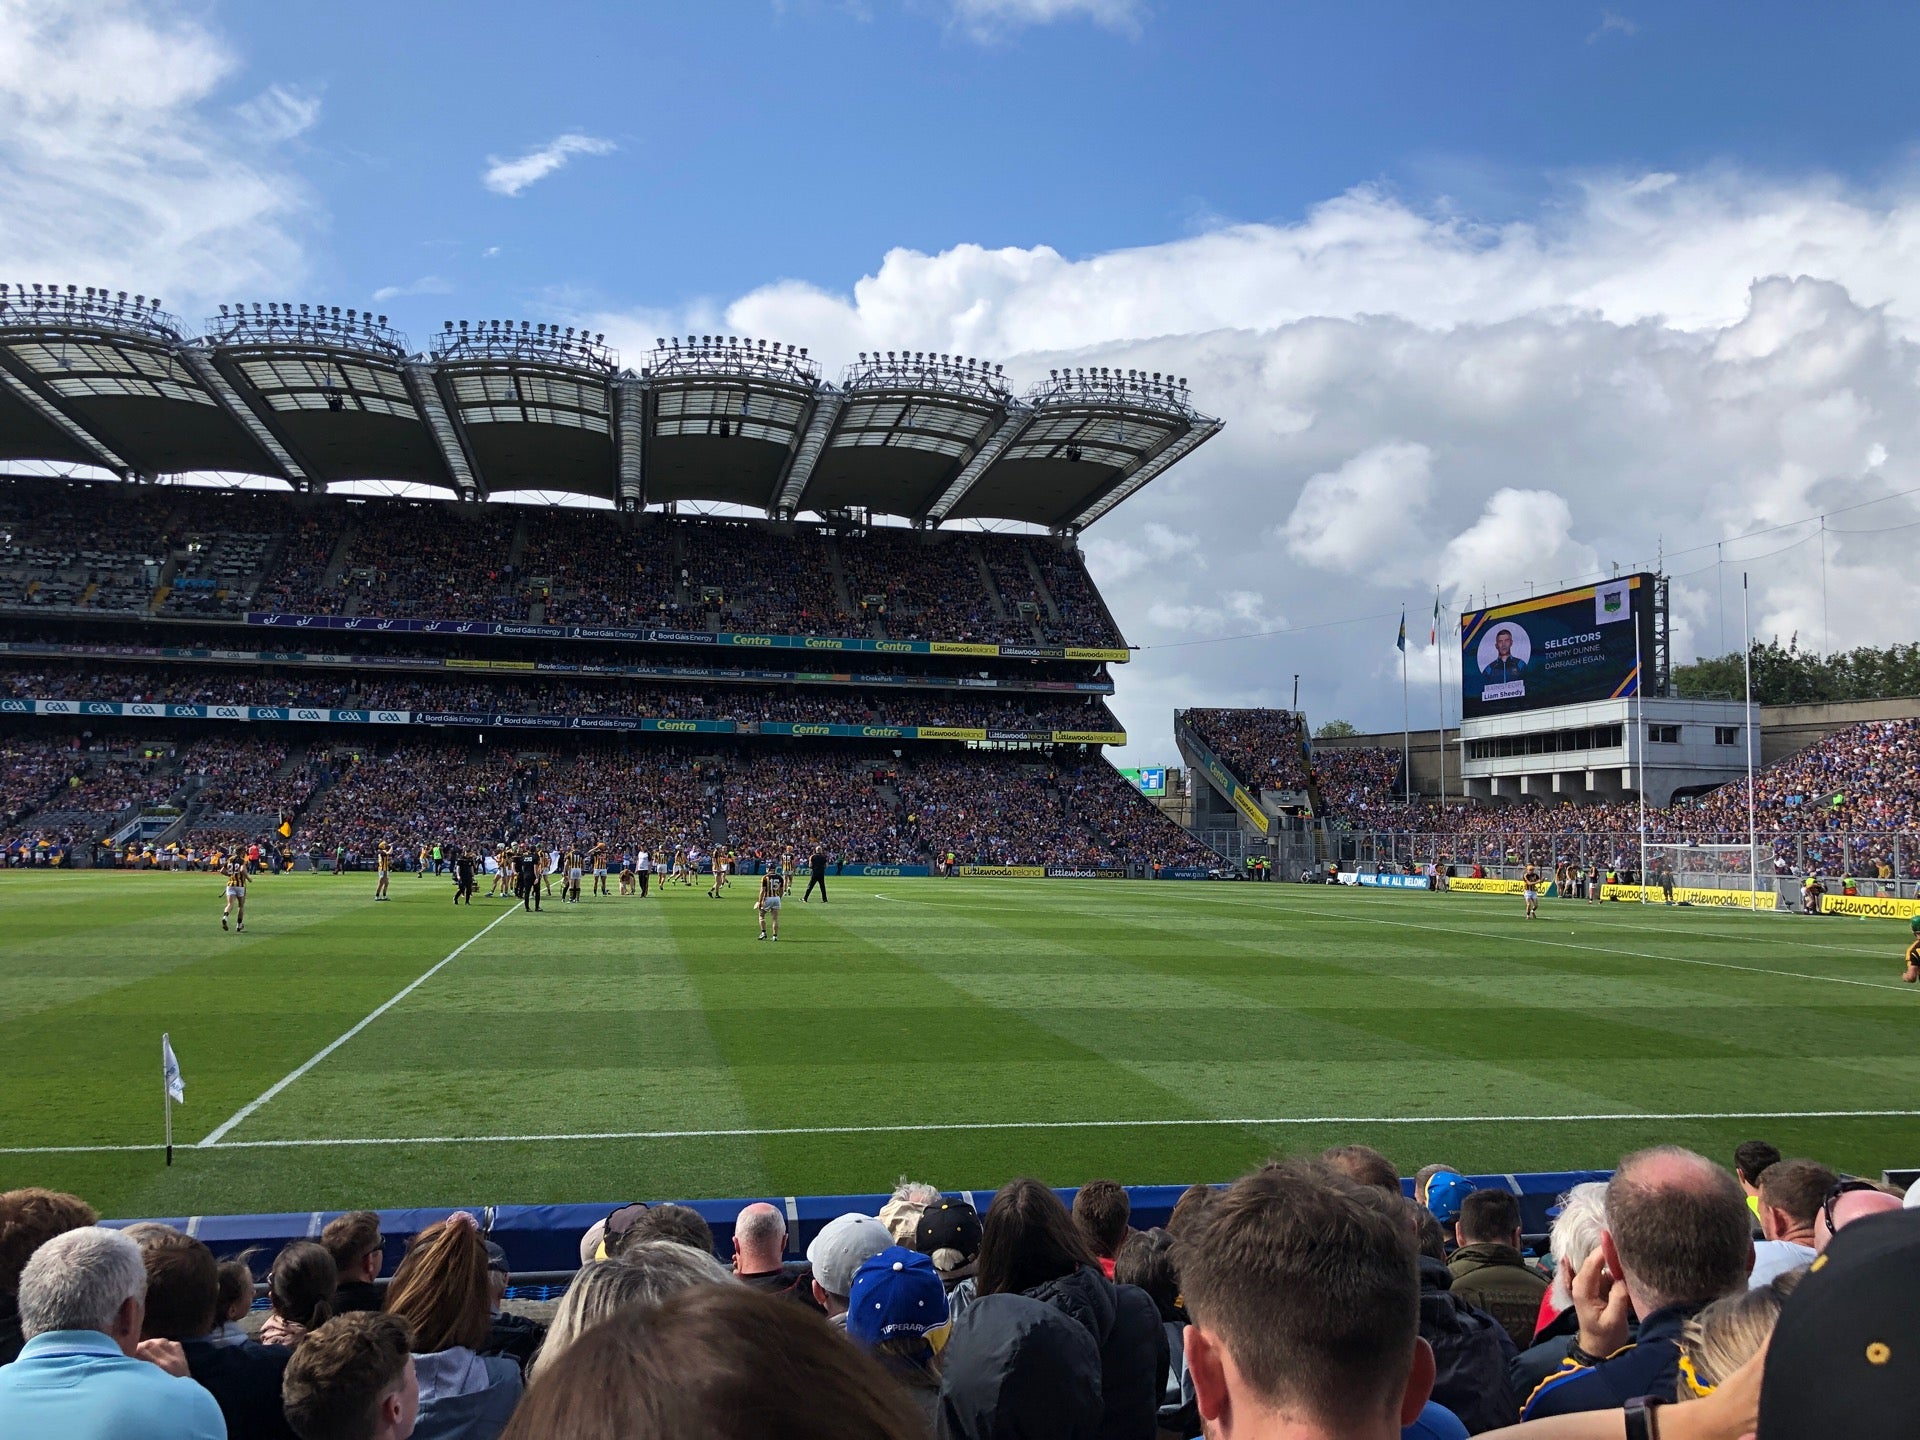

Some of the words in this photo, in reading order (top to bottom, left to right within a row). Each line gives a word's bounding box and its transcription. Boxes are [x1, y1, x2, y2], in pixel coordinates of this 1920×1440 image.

[521, 626, 537, 635] Gáis
[538, 627, 561, 637] Energy
[582, 629, 599, 637] Bord
[599, 629, 615, 638] Gáis
[615, 630, 639, 640] Energy
[658, 632, 675, 640] Bord
[675, 633, 690, 641] Gáis
[690, 634, 713, 643] Energy
[732, 634, 772, 646] Centra
[804, 637, 843, 649] Centra
[1544, 631, 1602, 650] SELECTORS
[875, 640, 912, 652] Centra
[1545, 649, 1571, 660] TOMMY
[1573, 643, 1601, 654] DUNNE
[537, 663, 578, 672] BoyleSports
[1544, 658, 1582, 670] DARRAGH
[1583, 654, 1606, 665] EGAN
[1484, 691, 1499, 700] Liam
[1500, 689, 1523, 699] Sheedy
[1, 700, 27, 711] GAA
[45, 701, 70, 712] GAA
[88, 702, 115, 714] GAA
[131, 704, 156, 715] GAA
[174, 704, 199, 716] GAA
[216, 707, 240, 717] GAA
[257, 708, 281, 719] GAA
[297, 709, 321, 720] GAA
[337, 711, 361, 721] GAA
[378, 711, 401, 722] GAA
[425, 714, 443, 722] Bord
[443, 714, 459, 723] Gáis
[458, 716, 484, 724] Energy
[504, 717, 521, 725] Bord
[521, 717, 537, 726] Gáis
[537, 718, 561, 727] Energy
[581, 719, 598, 727] Bord
[598, 719, 613, 728] Gáis
[613, 720, 638, 729] Energy
[656, 720, 697, 731] Centra
[791, 724, 830, 735] Centra
[862, 726, 899, 737] Centra
[1209, 761, 1229, 789] Centra
[863, 865, 901, 876] Centra
[770, 879, 781, 890] 15
[1381, 876, 1390, 885] WE
[1391, 876, 1402, 886] ALL
[1404, 877, 1427, 888] BELONG
[1885, 882, 1895, 890] 40
[880, 1323, 926, 1336] TIPPERARY
